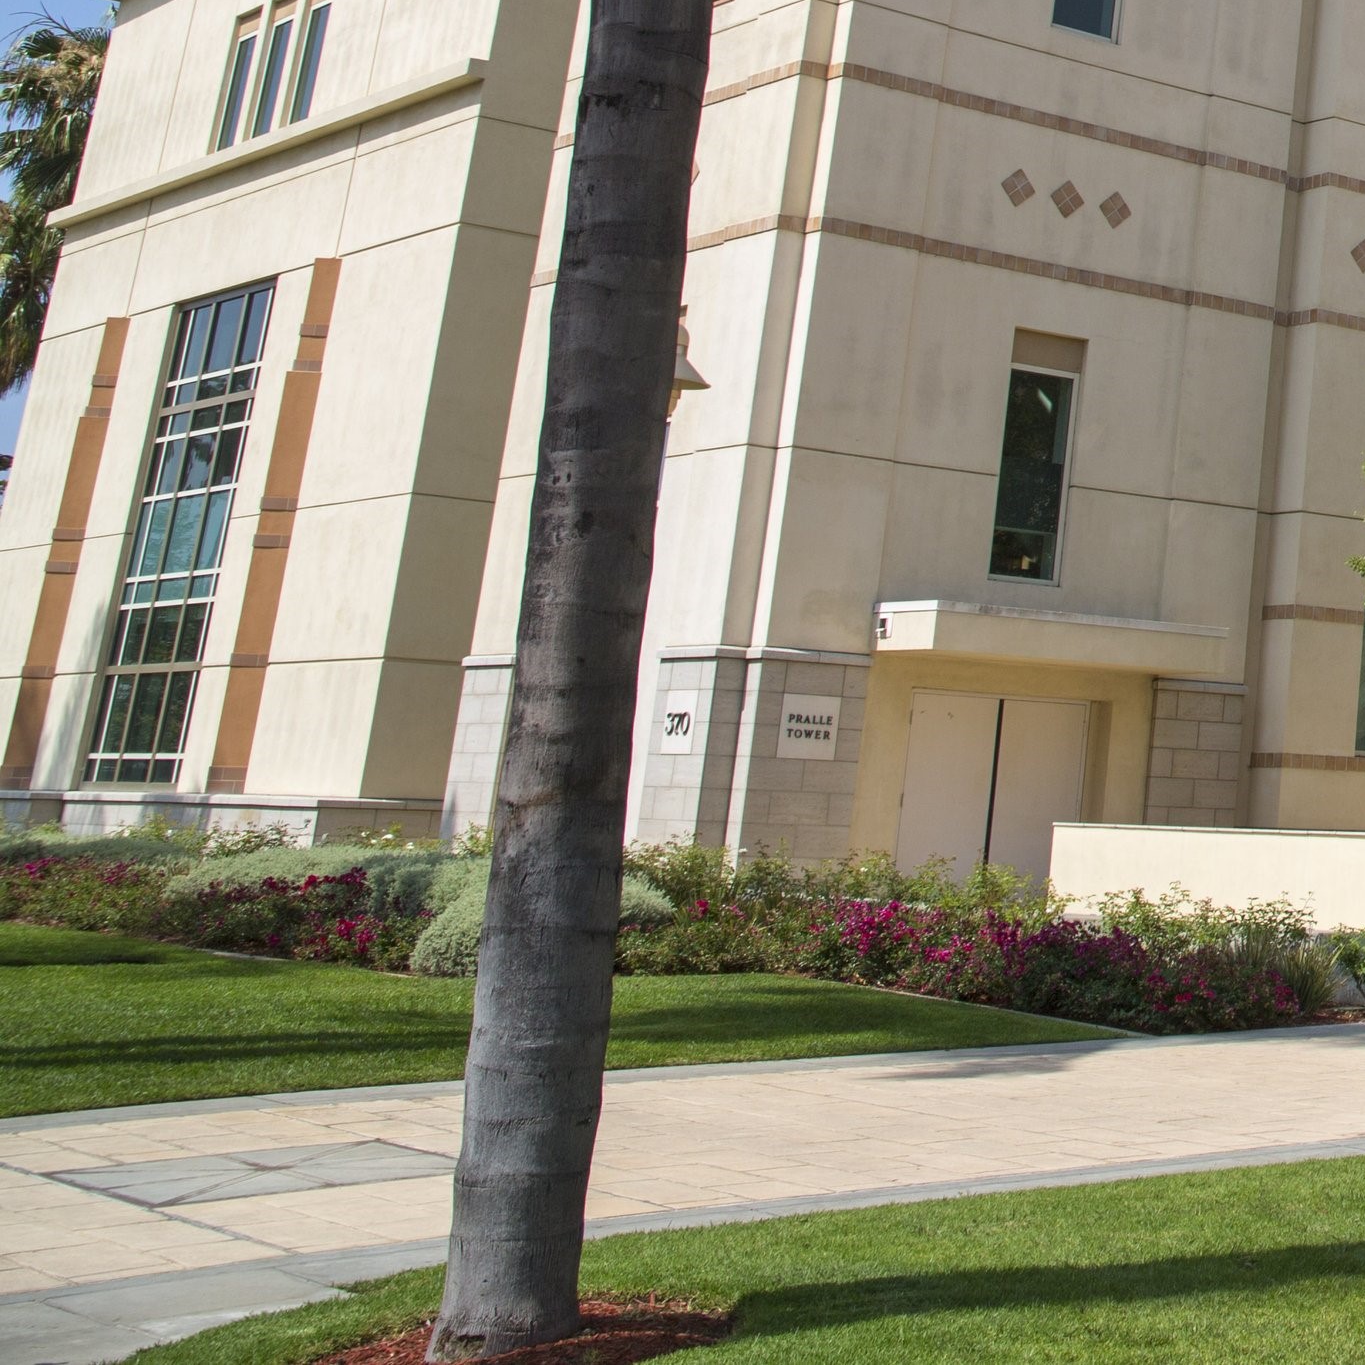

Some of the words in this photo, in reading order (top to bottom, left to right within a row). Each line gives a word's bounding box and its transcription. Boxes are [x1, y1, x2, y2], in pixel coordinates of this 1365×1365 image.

[664, 712, 691, 737] 370
[788, 713, 833, 726] PRALLE
[786, 728, 831, 741] TOWER
